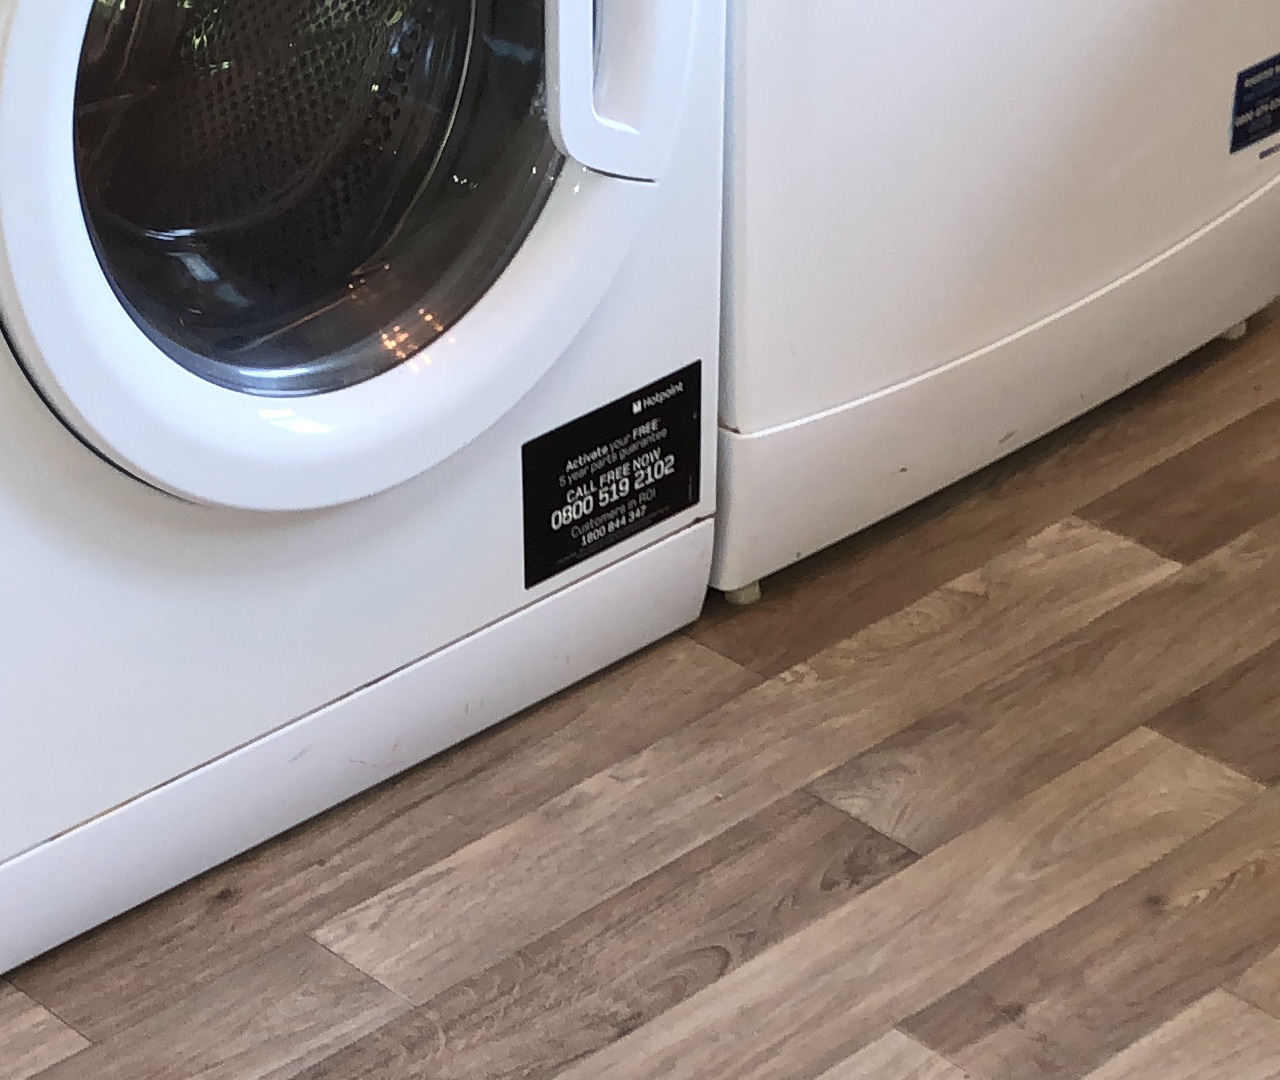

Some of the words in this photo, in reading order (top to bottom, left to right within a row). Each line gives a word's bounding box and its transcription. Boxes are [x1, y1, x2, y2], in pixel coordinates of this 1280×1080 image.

[566, 445, 608, 472] Activate
[609, 433, 631, 453] your
[566, 480, 597, 503] CALL
[599, 461, 630, 488] FREE
[632, 447, 661, 471] NOW
[567, 465, 589, 485] year
[619, 428, 667, 460] guarantee
[551, 495, 593, 530] 0800
[599, 477, 630, 507] 519
[634, 454, 675, 490] 2102
[570, 504, 626, 539] Customers
[627, 498, 637, 509] in
[639, 487, 656, 504] ROI
[581, 525, 606, 546] 1800
